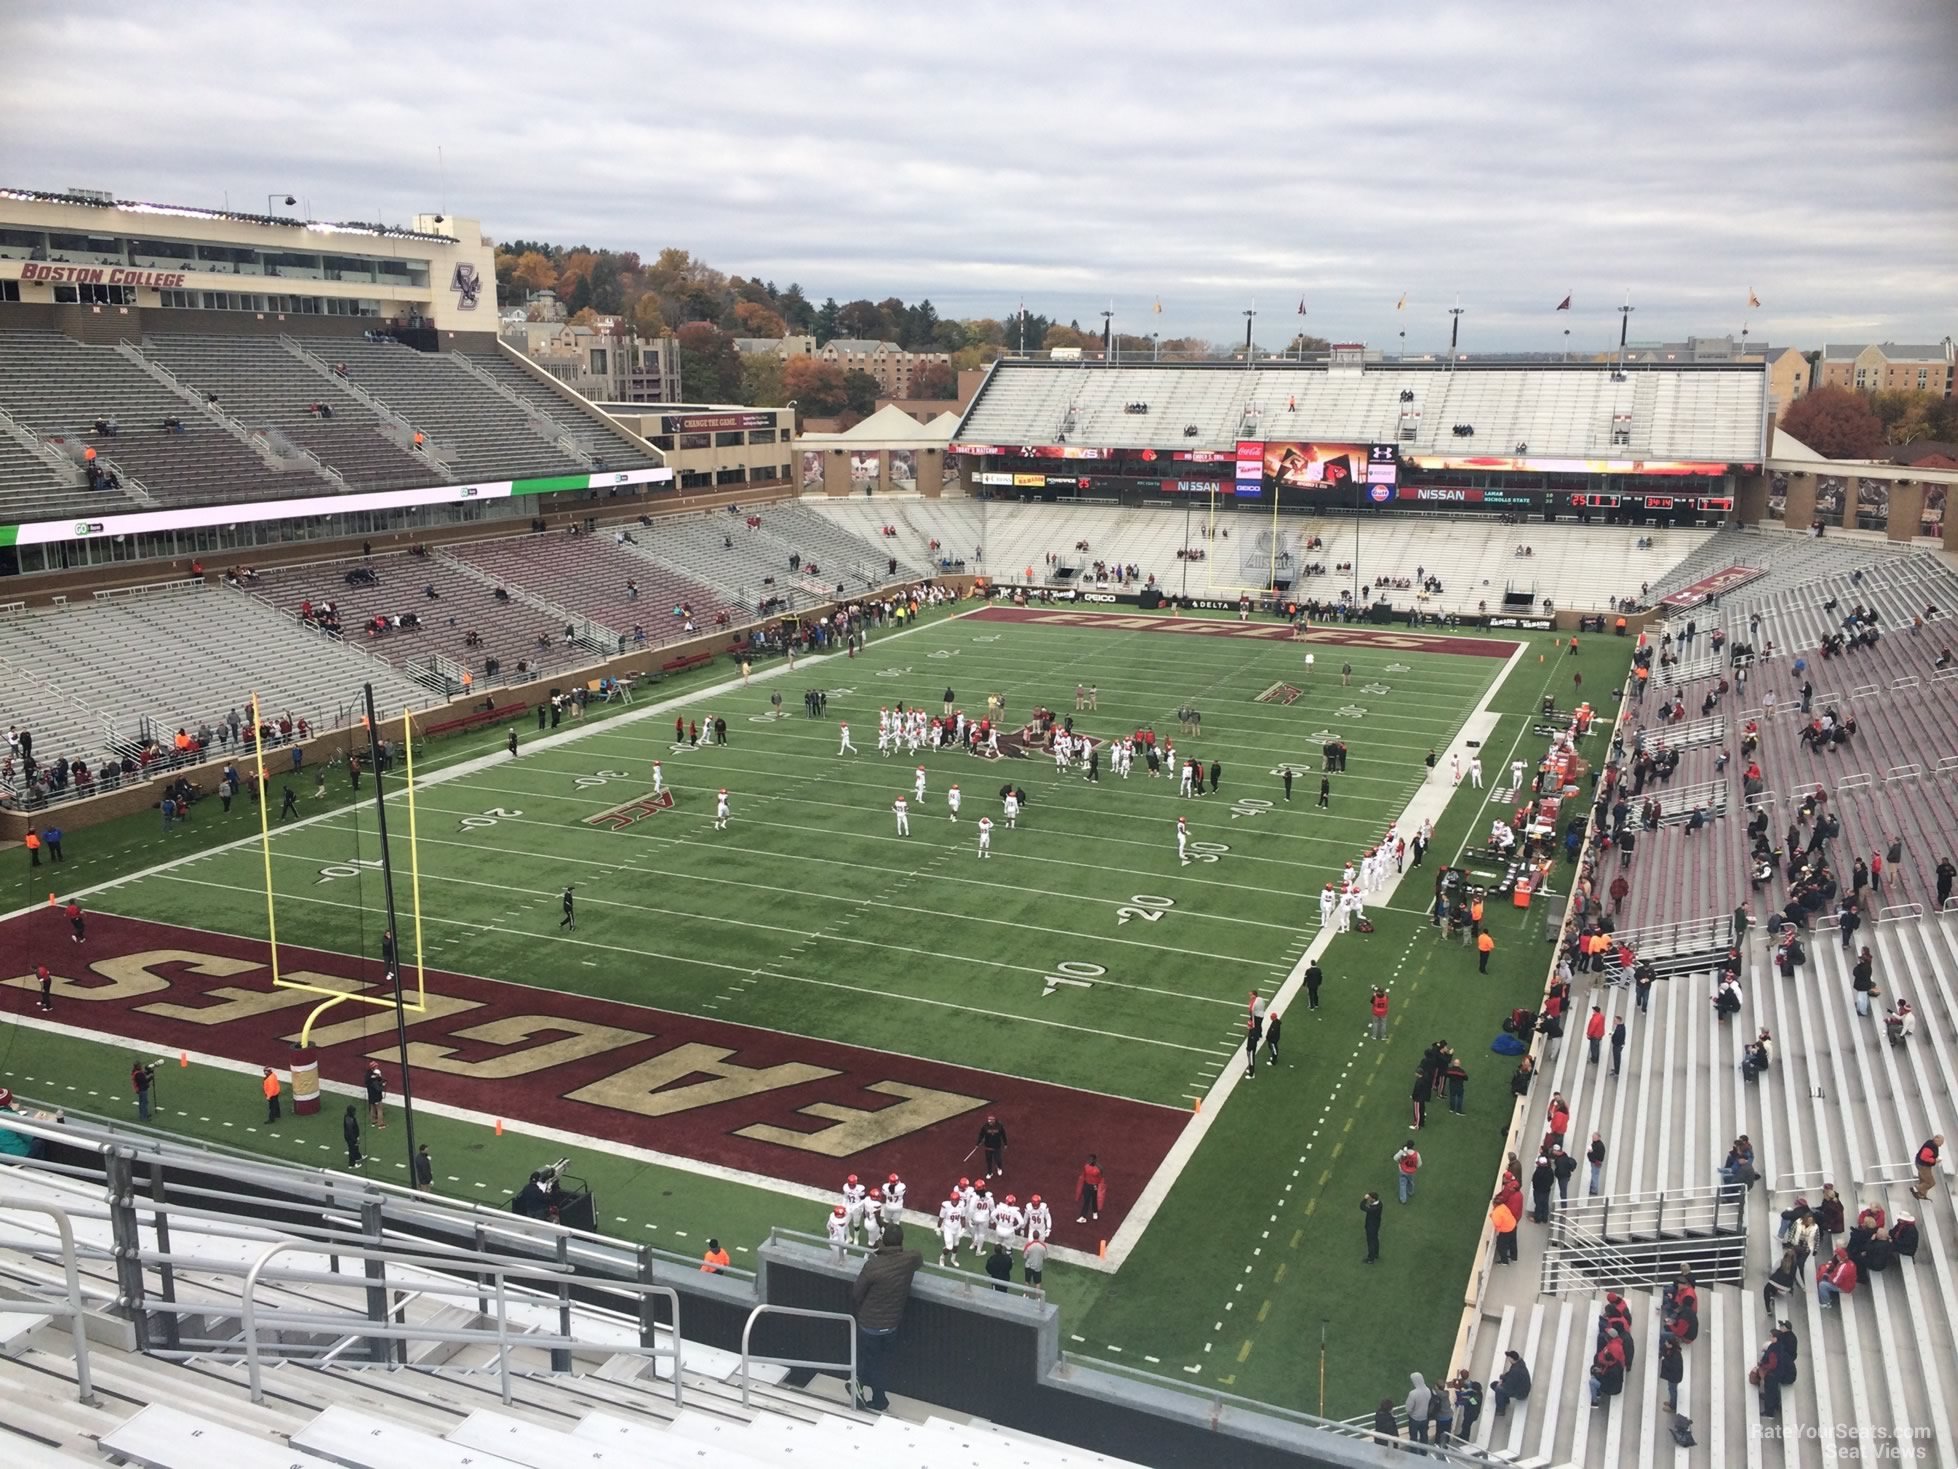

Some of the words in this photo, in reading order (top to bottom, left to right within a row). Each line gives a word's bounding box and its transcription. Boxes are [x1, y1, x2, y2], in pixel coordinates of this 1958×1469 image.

[21, 263, 104, 284] BOSTON
[109, 269, 185, 288] COLLEGE
[1178, 481, 1220, 492] NISSAN
[1417, 489, 1465, 501] NISSAN
[1084, 593, 1116, 602] GEICO
[1200, 601, 1229, 609] DELTA
[574, 770, 630, 786] 30
[1269, 762, 1311, 777] 50
[1230, 798, 1275, 816] 40
[459, 808, 523, 828] 20
[1183, 841, 1231, 863] 30
[318, 858, 384, 878] 10
[1116, 894, 1175, 921] 20
[1044, 961, 1107, 988] 10
[0, 949, 994, 1158] EAGLES
[1000, 1212, 1011, 1224] 44
